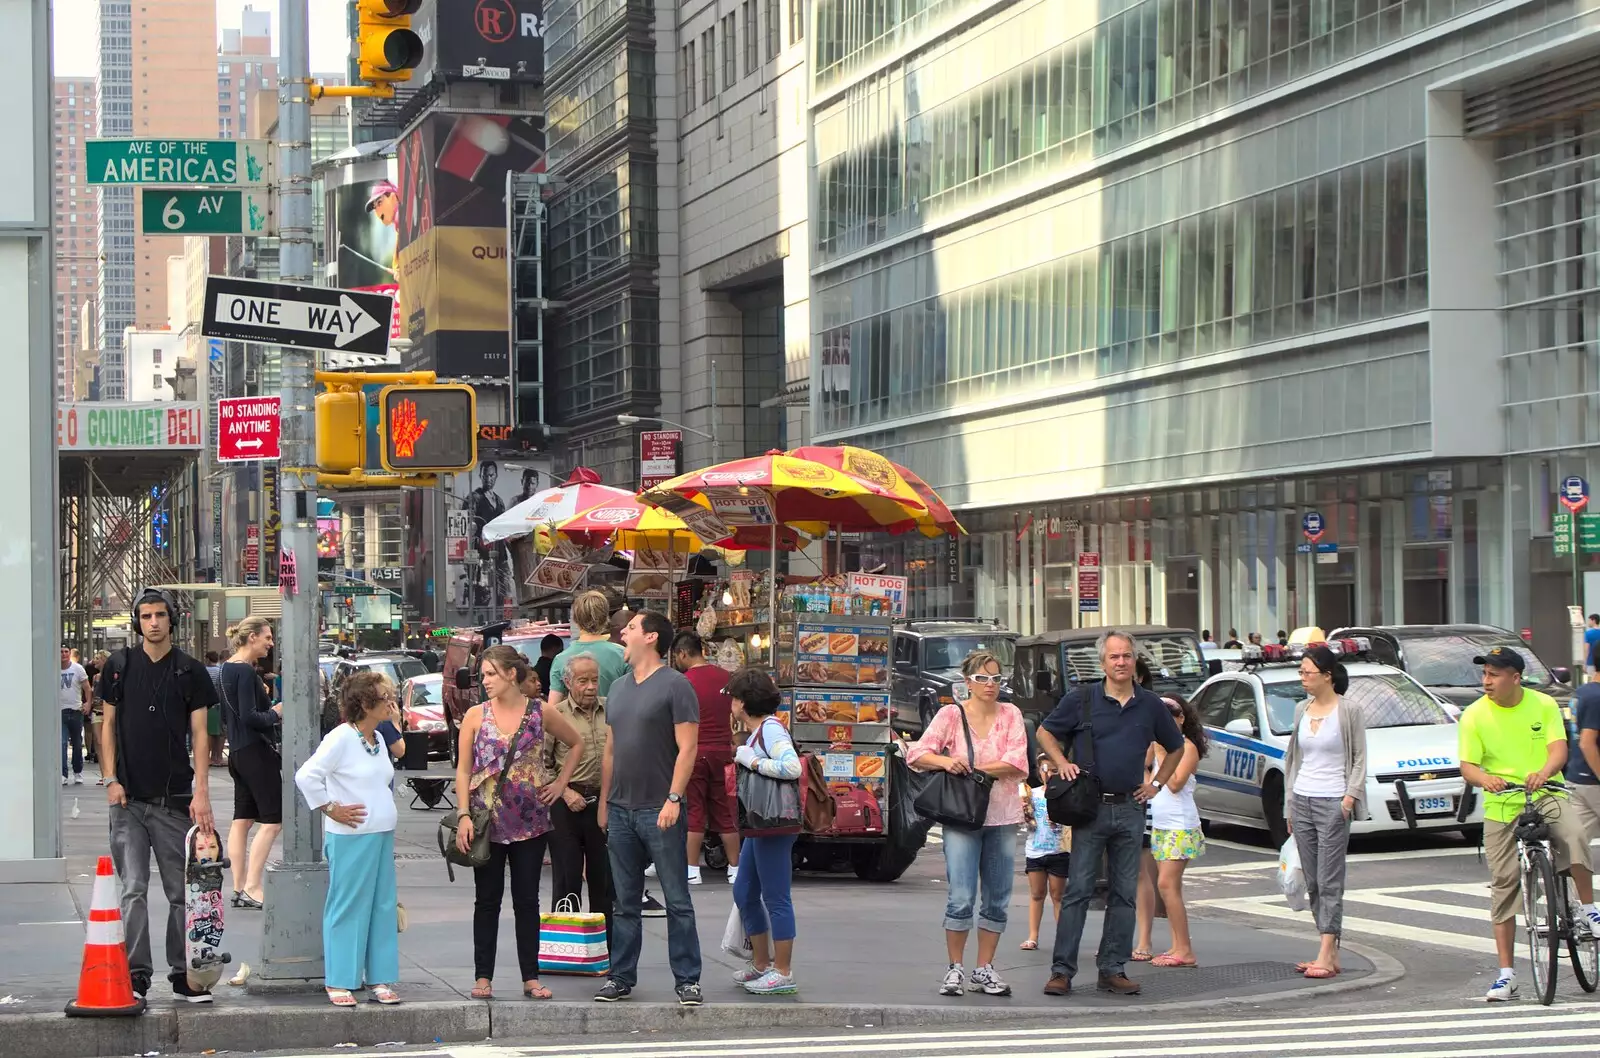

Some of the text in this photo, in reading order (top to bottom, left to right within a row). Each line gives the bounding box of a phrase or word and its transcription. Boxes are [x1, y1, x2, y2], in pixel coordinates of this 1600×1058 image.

[128, 142, 208, 154] AVE OF THE
[103, 158, 236, 182] AMERICAS
[162, 196, 224, 230] 6 AV
[472, 246, 507, 259] QUI
[230, 299, 282, 324] ONE
[308, 308, 362, 333] WAY
[222, 402, 278, 418] NO STANDING
[88, 409, 163, 446] GOURMET
[168, 408, 201, 444] DELI
[228, 420, 270, 434] ANYTIME
[854, 576, 902, 590] HOT DOG
[1224, 748, 1256, 780] NYPD
[1396, 757, 1452, 768] POLICE
[1418, 797, 1446, 810] 3395
